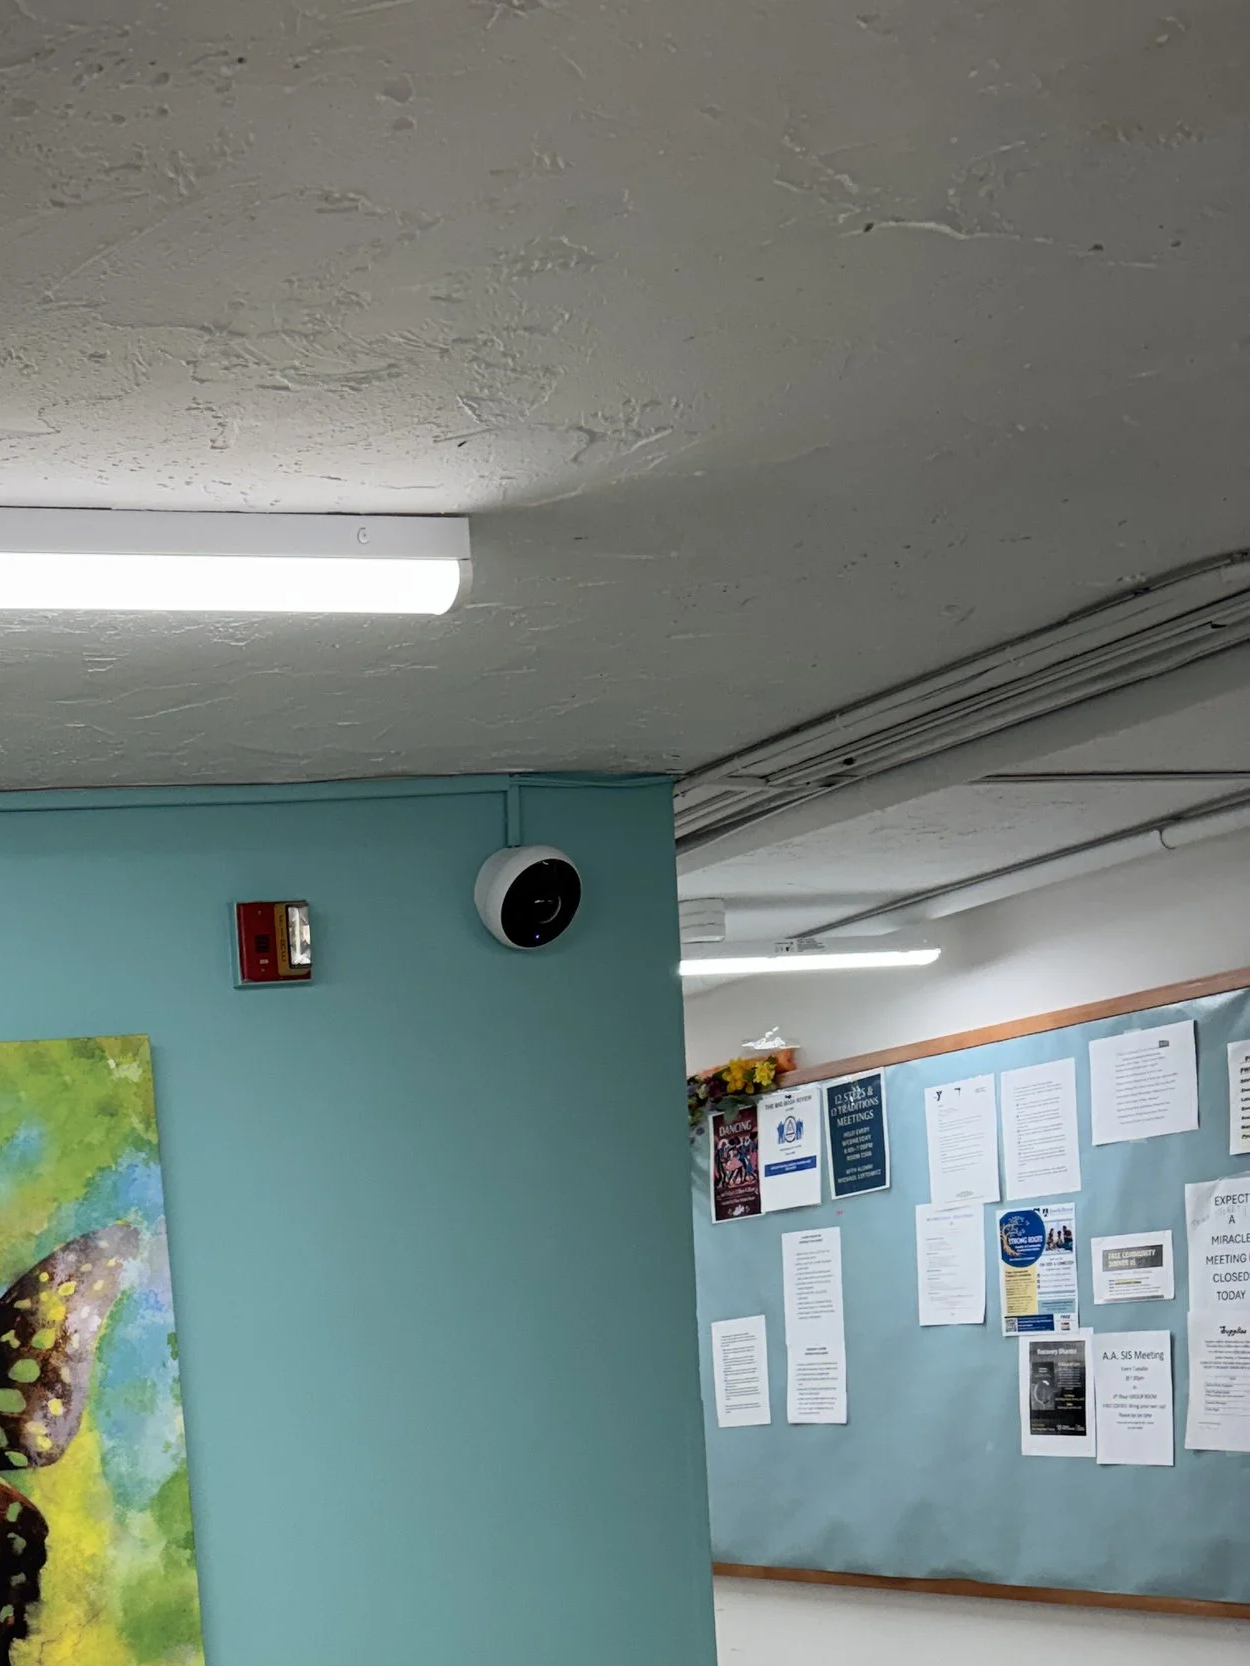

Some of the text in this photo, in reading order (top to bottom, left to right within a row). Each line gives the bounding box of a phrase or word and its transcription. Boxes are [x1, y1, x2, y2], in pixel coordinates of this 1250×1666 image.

[796, 1095, 812, 1103] REVIEW
[834, 1086, 874, 1104] 12 STEPS &
[837, 1096, 879, 1114] TRADITIONS
[837, 1109, 874, 1126] MEETINGS
[719, 1120, 752, 1137] DANCING
[842, 1134, 872, 1146] WEDNESDAY
[1214, 1193, 1249, 1206] EXPECT
[1228, 1214, 1236, 1224] A
[1211, 1233, 1250, 1246] MIRACLE
[1206, 1254, 1247, 1265] MEETING
[1212, 1272, 1249, 1283] CLOSED
[1217, 1290, 1246, 1301] TODAY
[1219, 1326, 1247, 1336] Supplies
[1102, 1350, 1164, 1361] A.A. SIS Meeting
